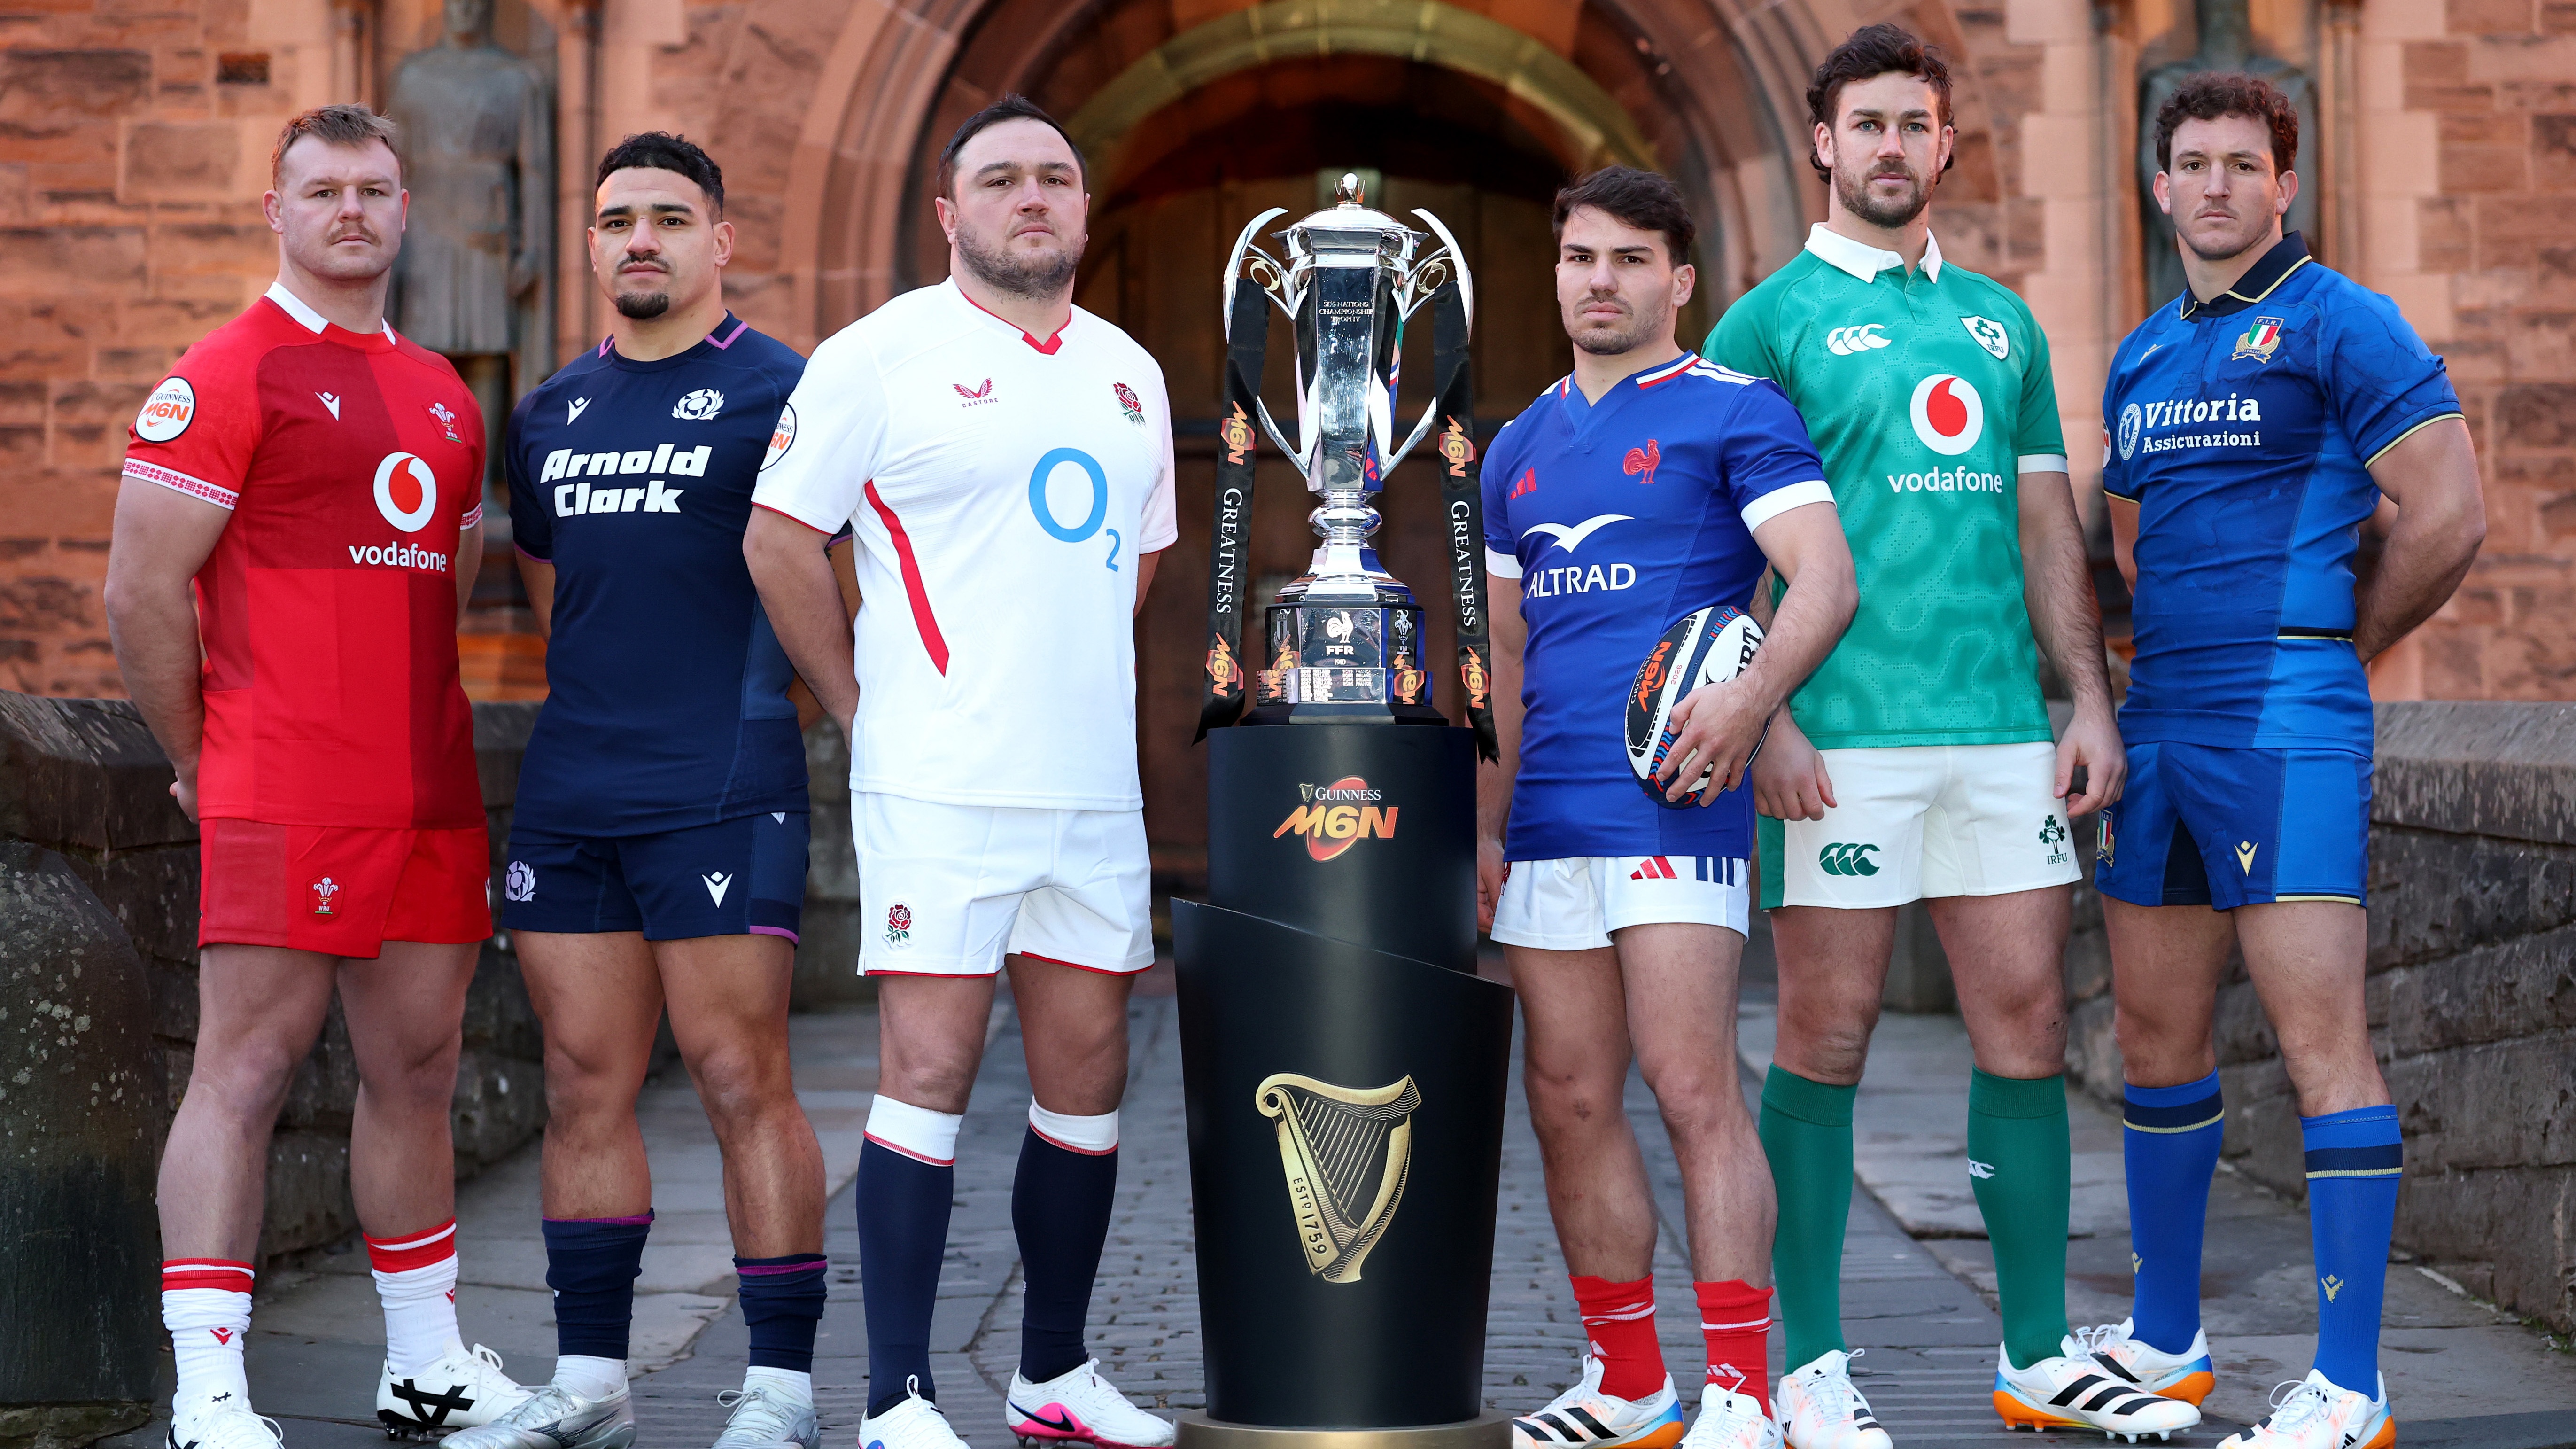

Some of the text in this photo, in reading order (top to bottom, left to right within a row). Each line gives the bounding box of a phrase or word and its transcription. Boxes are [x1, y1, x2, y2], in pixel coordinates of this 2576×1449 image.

[1986, 344, 2004, 353] IRFU
[156, 393, 191, 403] GUINNESS
[962, 398, 998, 408] CASTORE
[2145, 392, 2261, 428] Vittoria
[2142, 430, 2261, 453] Assicurazioni
[540, 443, 713, 484] Arnold
[1887, 465, 2002, 493] vodafone
[554, 480, 684, 517] Clark
[348, 541, 446, 572] vodafone
[1216, 488, 1242, 614] GREATNESS
[1451, 500, 1476, 627] GREATNESS
[1526, 563, 1636, 599] ALTRAD
[1326, 645, 1354, 655] FFR
[1671, 664, 1683, 685] 2026
[1315, 787, 1381, 801] GUINNESS
[2047, 853, 2067, 865] IRFU
[1302, 1213, 1327, 1254] 1759
